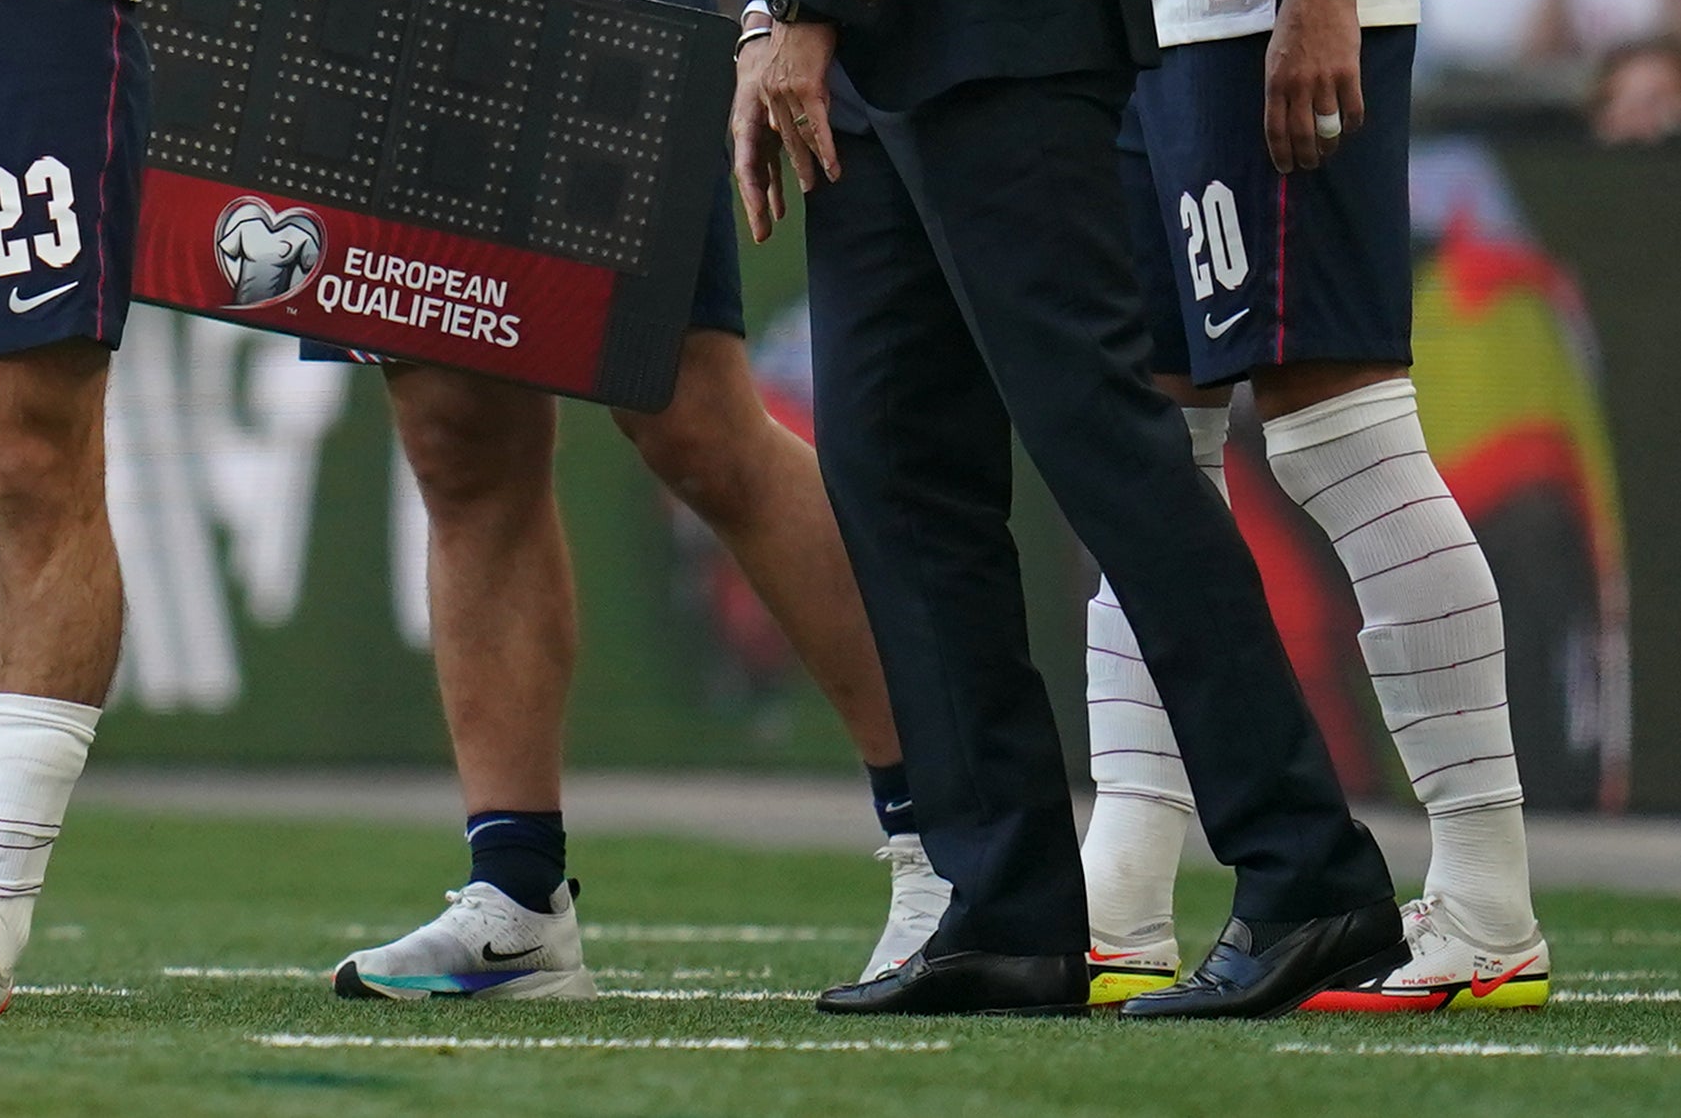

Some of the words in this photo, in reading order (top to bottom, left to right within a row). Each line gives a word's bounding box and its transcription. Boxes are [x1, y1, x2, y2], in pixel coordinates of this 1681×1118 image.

[344, 246, 508, 308] EUROPEAN
[1179, 180, 1250, 301] 20
[316, 274, 521, 348] QUALIFIERS
